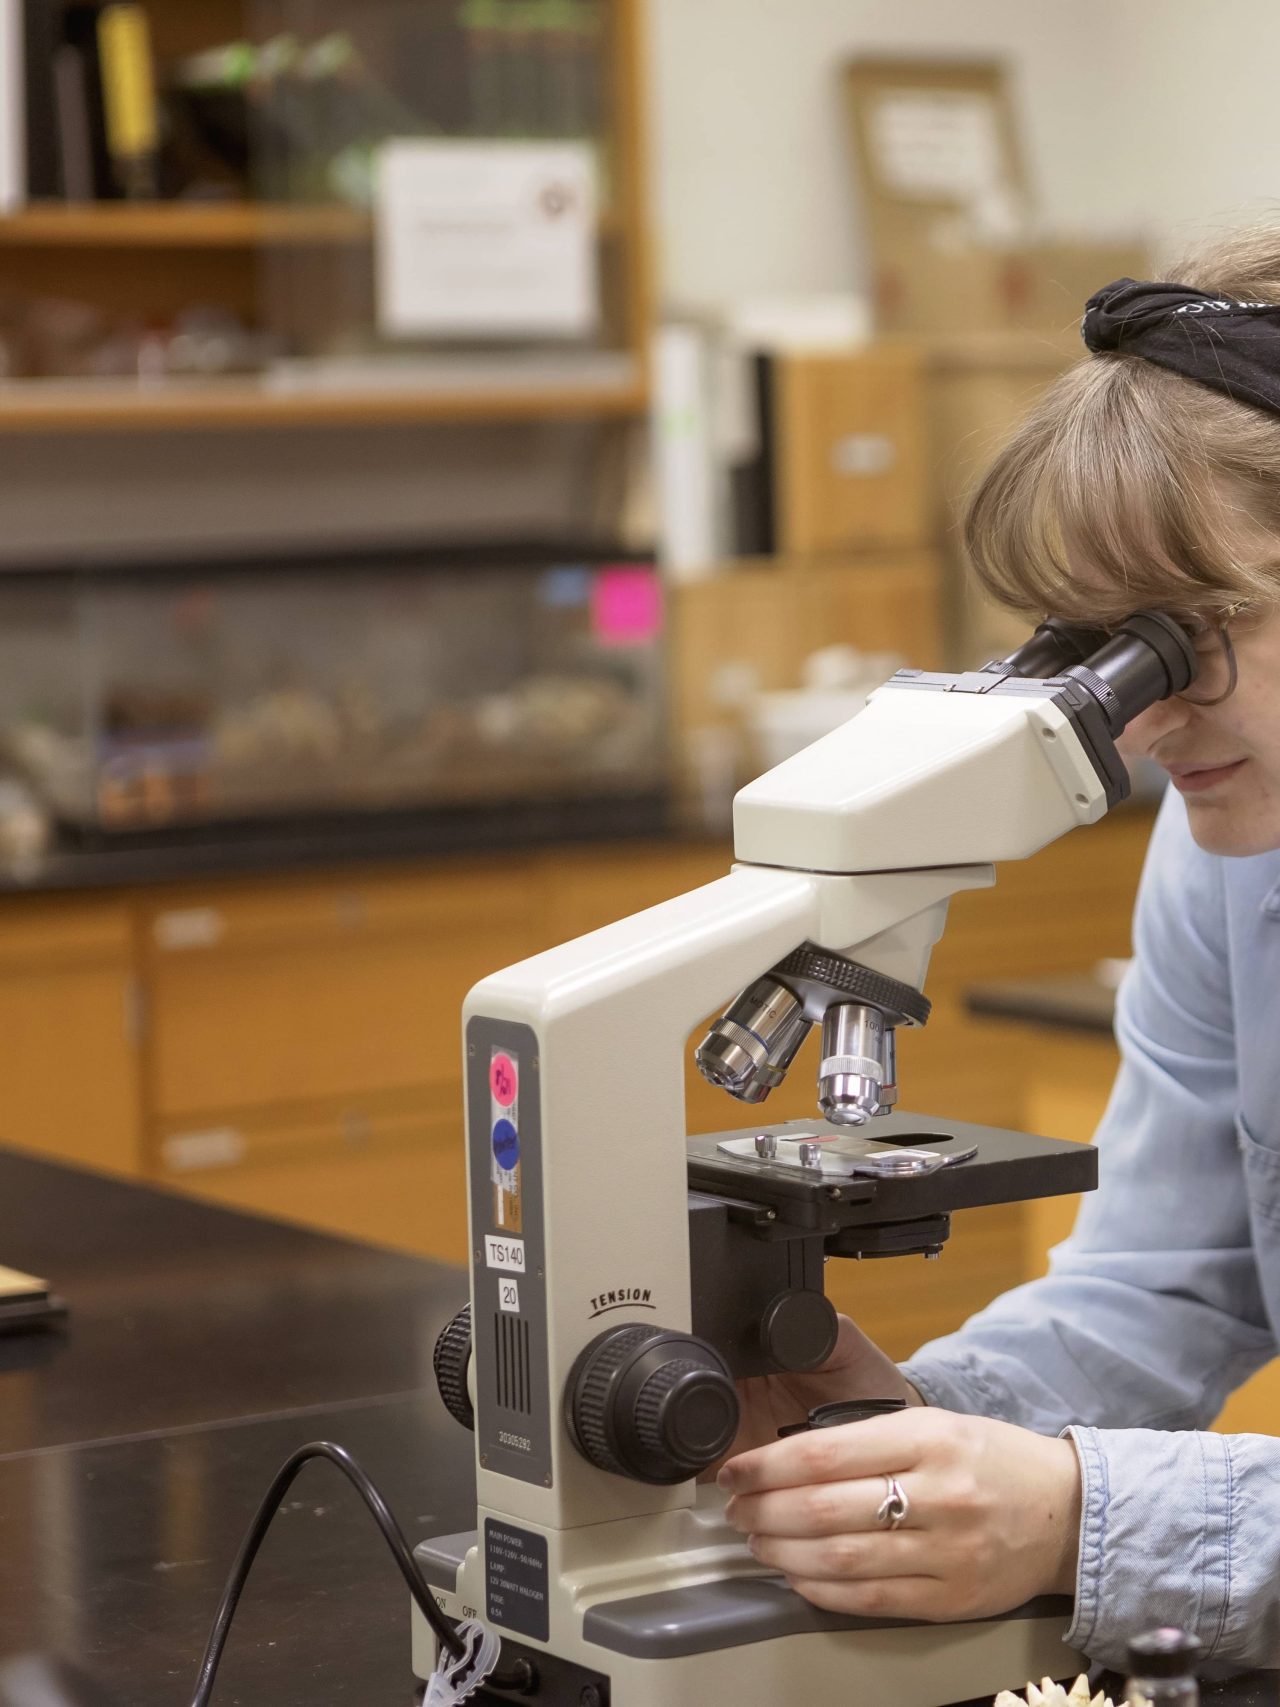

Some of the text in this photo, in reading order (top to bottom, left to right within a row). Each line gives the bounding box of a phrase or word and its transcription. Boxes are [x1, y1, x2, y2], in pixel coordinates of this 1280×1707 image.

[490, 1243, 523, 1265] TS140
[503, 1286, 517, 1305] 20
[590, 1288, 651, 1310] TENSION
[436, 1596, 446, 1608] ON
[462, 1606, 477, 1618] OFF
